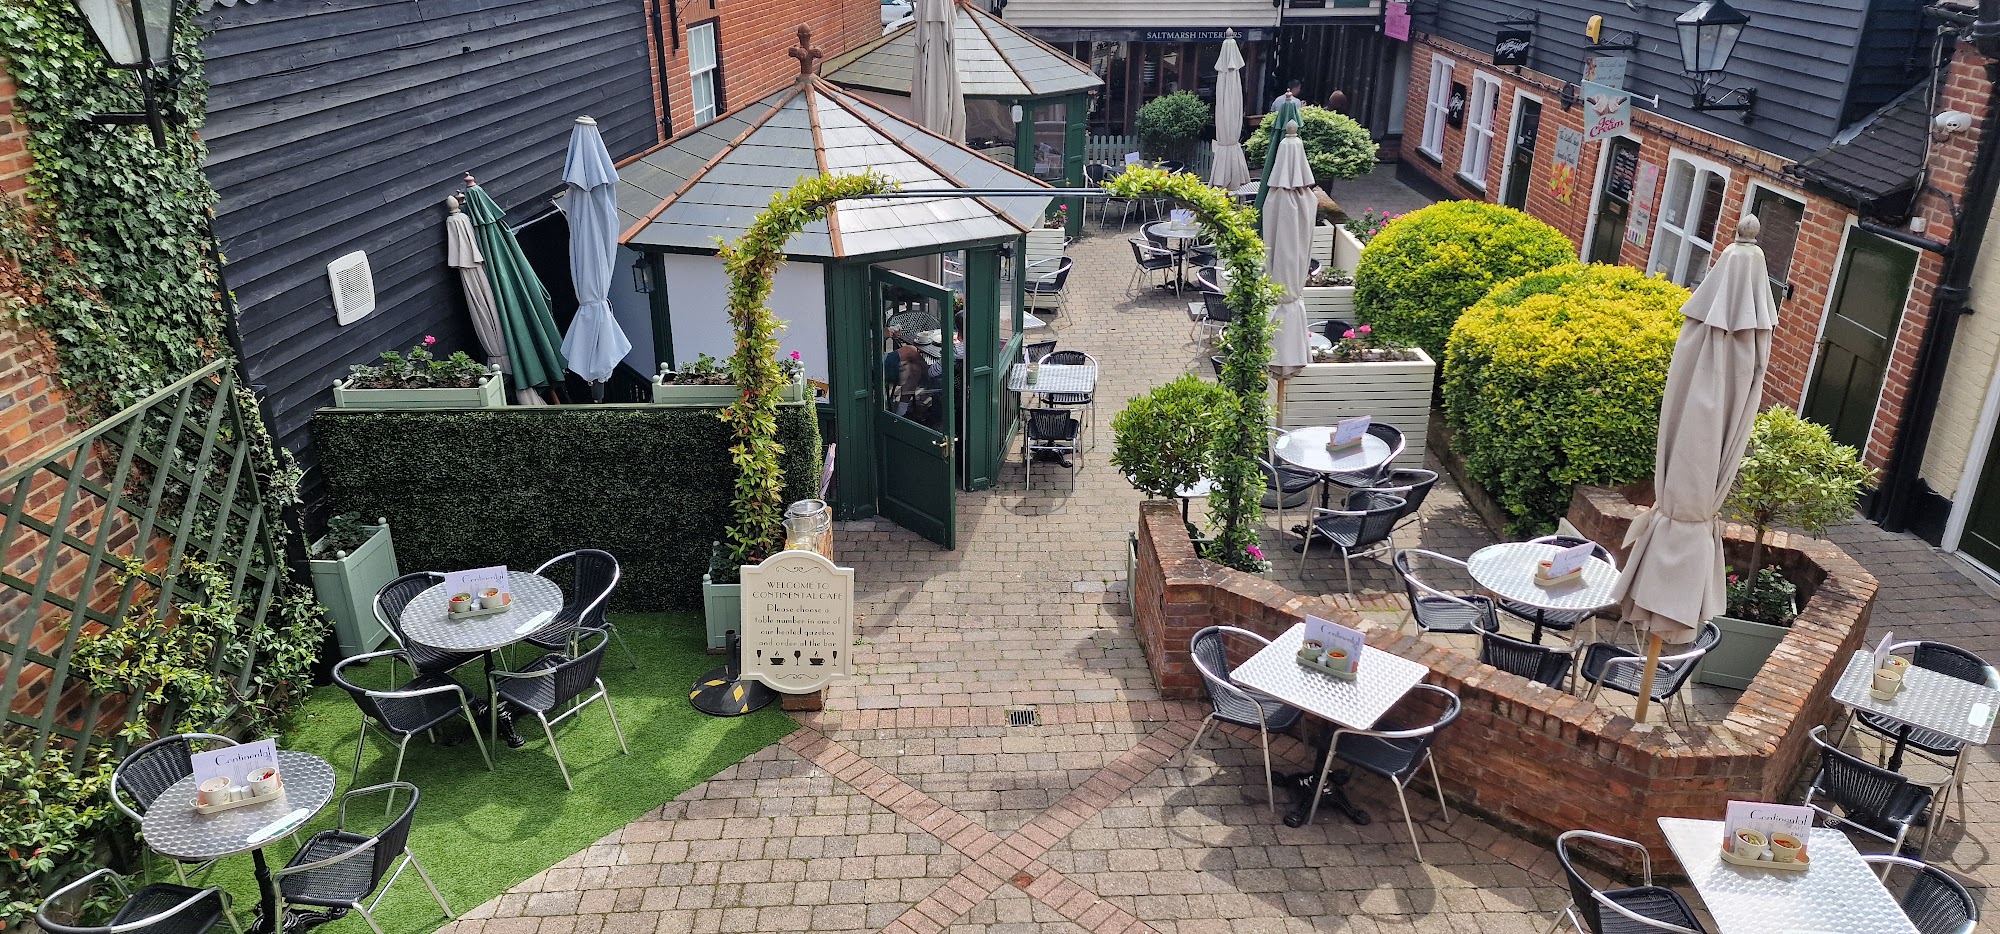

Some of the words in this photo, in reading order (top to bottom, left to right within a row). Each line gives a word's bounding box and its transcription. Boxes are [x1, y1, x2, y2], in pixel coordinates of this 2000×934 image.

[1146, 31, 1197, 39] SALTMARSH
[1198, 31, 1243, 39] INTERIRS
[1598, 116, 1616, 128] Ice
[1589, 119, 1625, 138] Cream
[767, 582, 814, 590] WELCOME
[817, 582, 830, 590] TO
[752, 591, 818, 600] CONTINENTAL
[819, 593, 843, 601] CAFE
[766, 603, 794, 613] Please
[796, 605, 822, 613] choose
[755, 615, 774, 624] table
[776, 615, 805, 624] number
[832, 616, 841, 625] of
[776, 626, 802, 635] heated
[758, 638, 773, 647] and
[775, 639, 798, 647] order
[809, 639, 821, 647] the
[823, 639, 837, 647] bar
[214, 745, 272, 766] Continental
[1750, 809, 1808, 826] Continental
